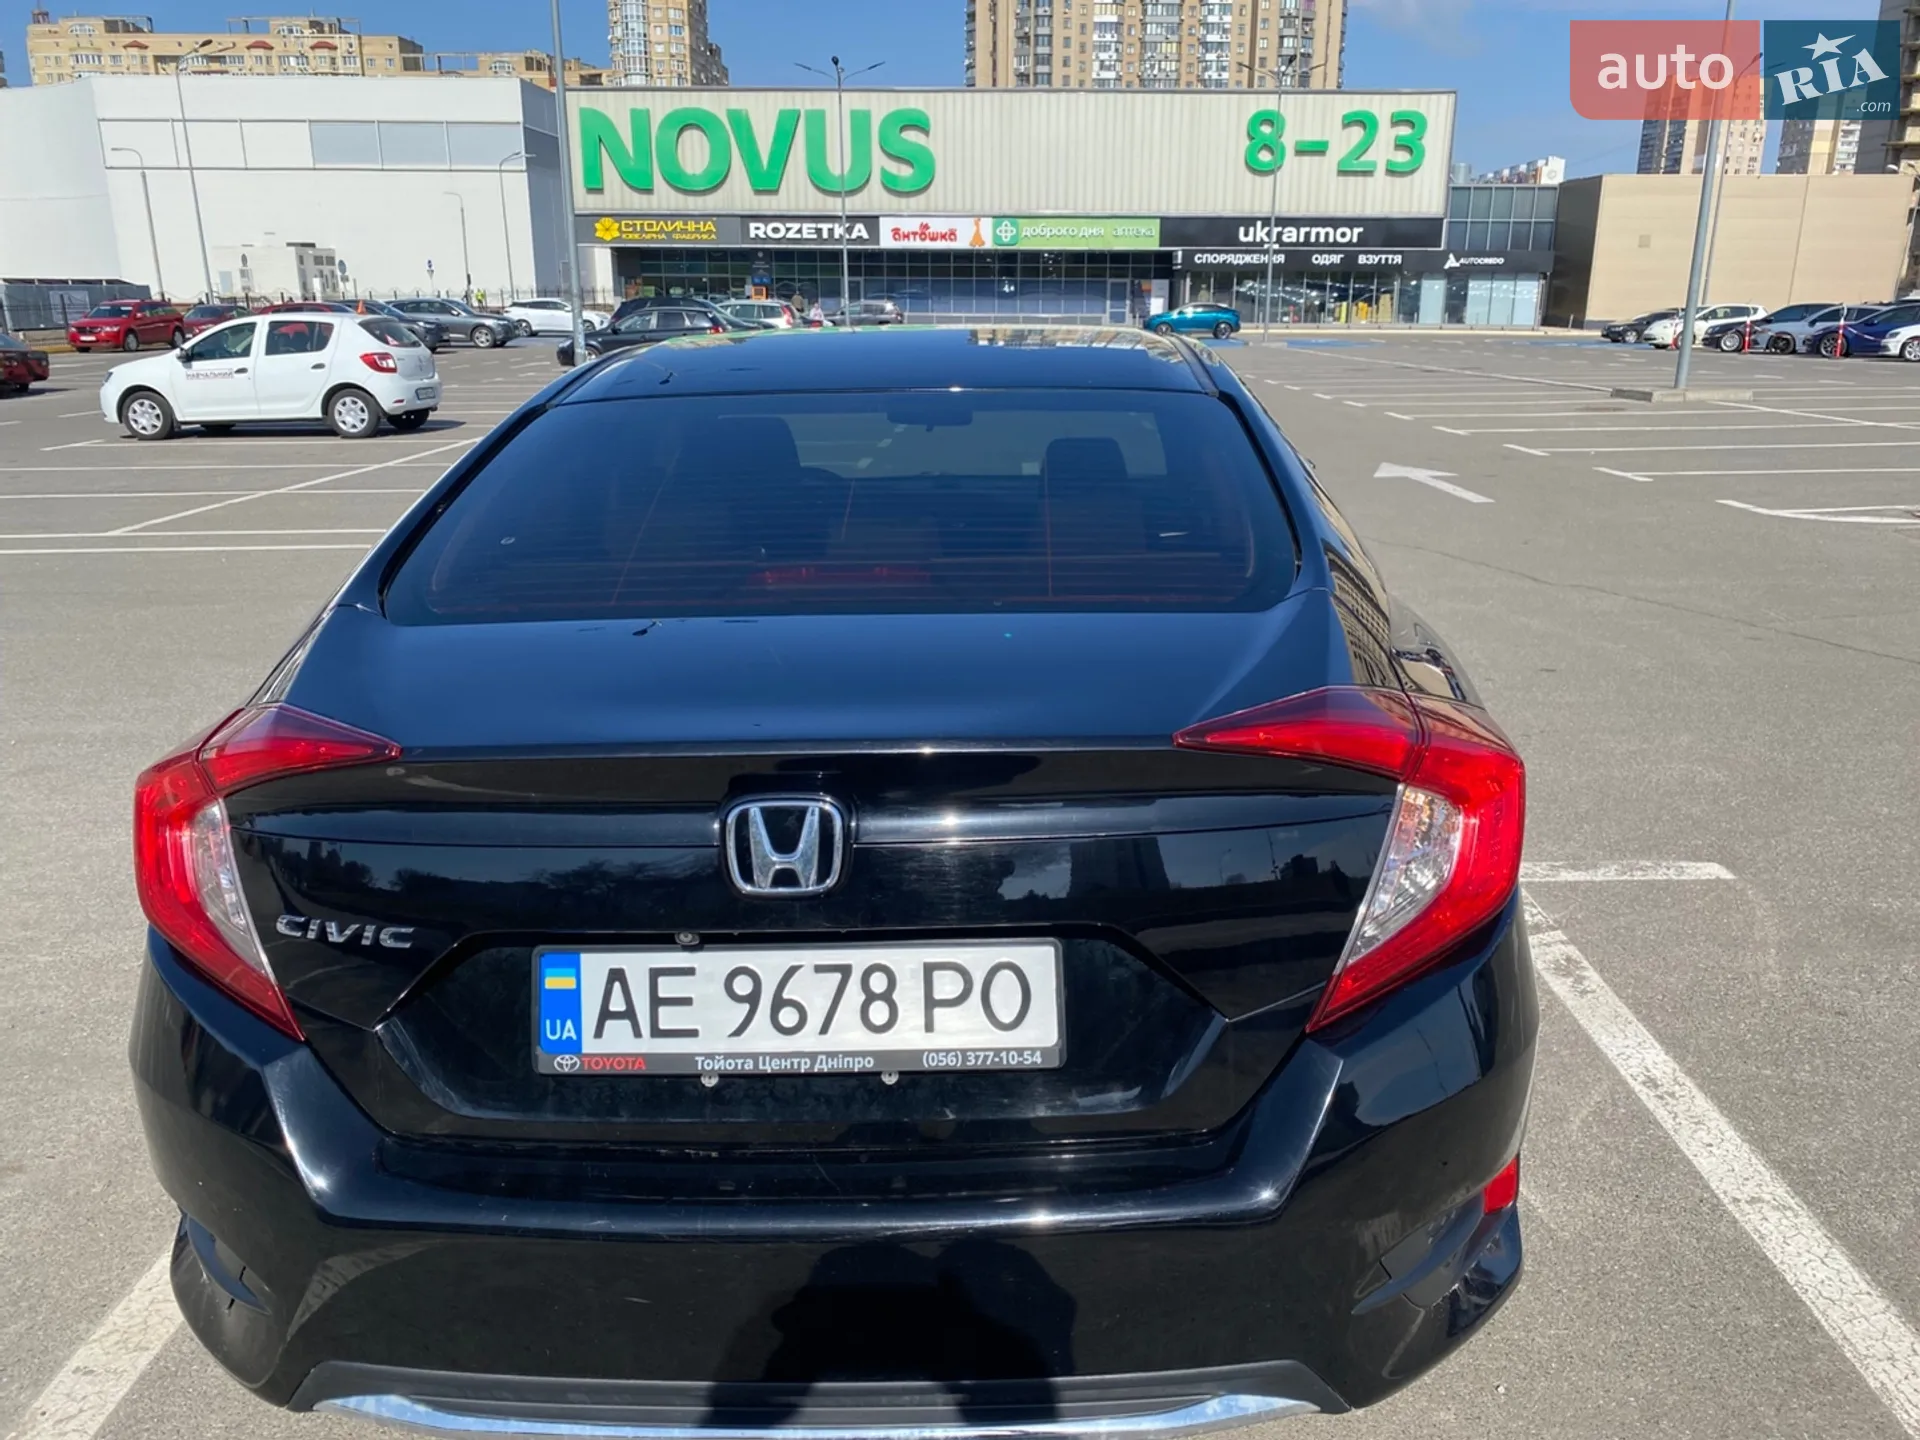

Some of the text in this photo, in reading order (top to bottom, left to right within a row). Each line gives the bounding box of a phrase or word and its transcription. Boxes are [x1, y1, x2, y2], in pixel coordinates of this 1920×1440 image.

[578, 107, 936, 194] NOVUS
[621, 220, 717, 232] СТОЛИЧНА
[749, 222, 870, 240] ROZETKA
[1022, 224, 1155, 239] доброго дня аптека
[1238, 220, 1364, 243] ukrarmor
[1312, 253, 1345, 265] ОДЯГ
[1357, 253, 1403, 265] ВЗУТТЯ
[275, 913, 416, 949] CIVIC
[593, 965, 699, 1040] AE
[723, 961, 899, 1038] 9678
[546, 1019, 577, 1041] UA
[582, 1056, 647, 1072] TOYOTA
[695, 1050, 1042, 1073] Тойота Центр Дніпро (056) 377-10-54
